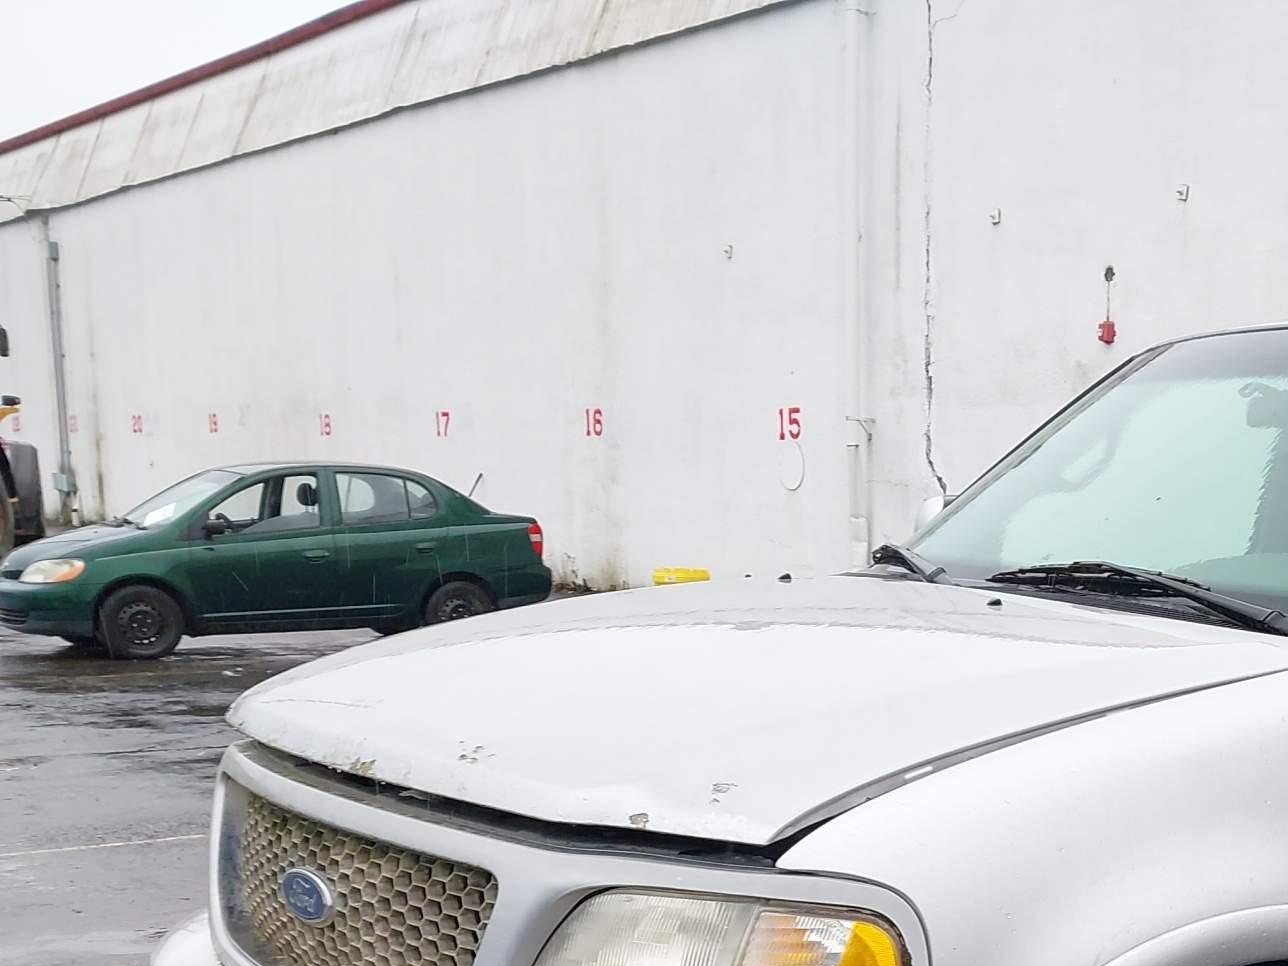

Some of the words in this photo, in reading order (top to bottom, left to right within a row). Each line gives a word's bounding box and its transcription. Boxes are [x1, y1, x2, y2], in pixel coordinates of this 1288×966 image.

[319, 413, 332, 436] 18
[435, 411, 450, 437] 17
[584, 408, 604, 437] 16
[778, 407, 802, 441] 15
